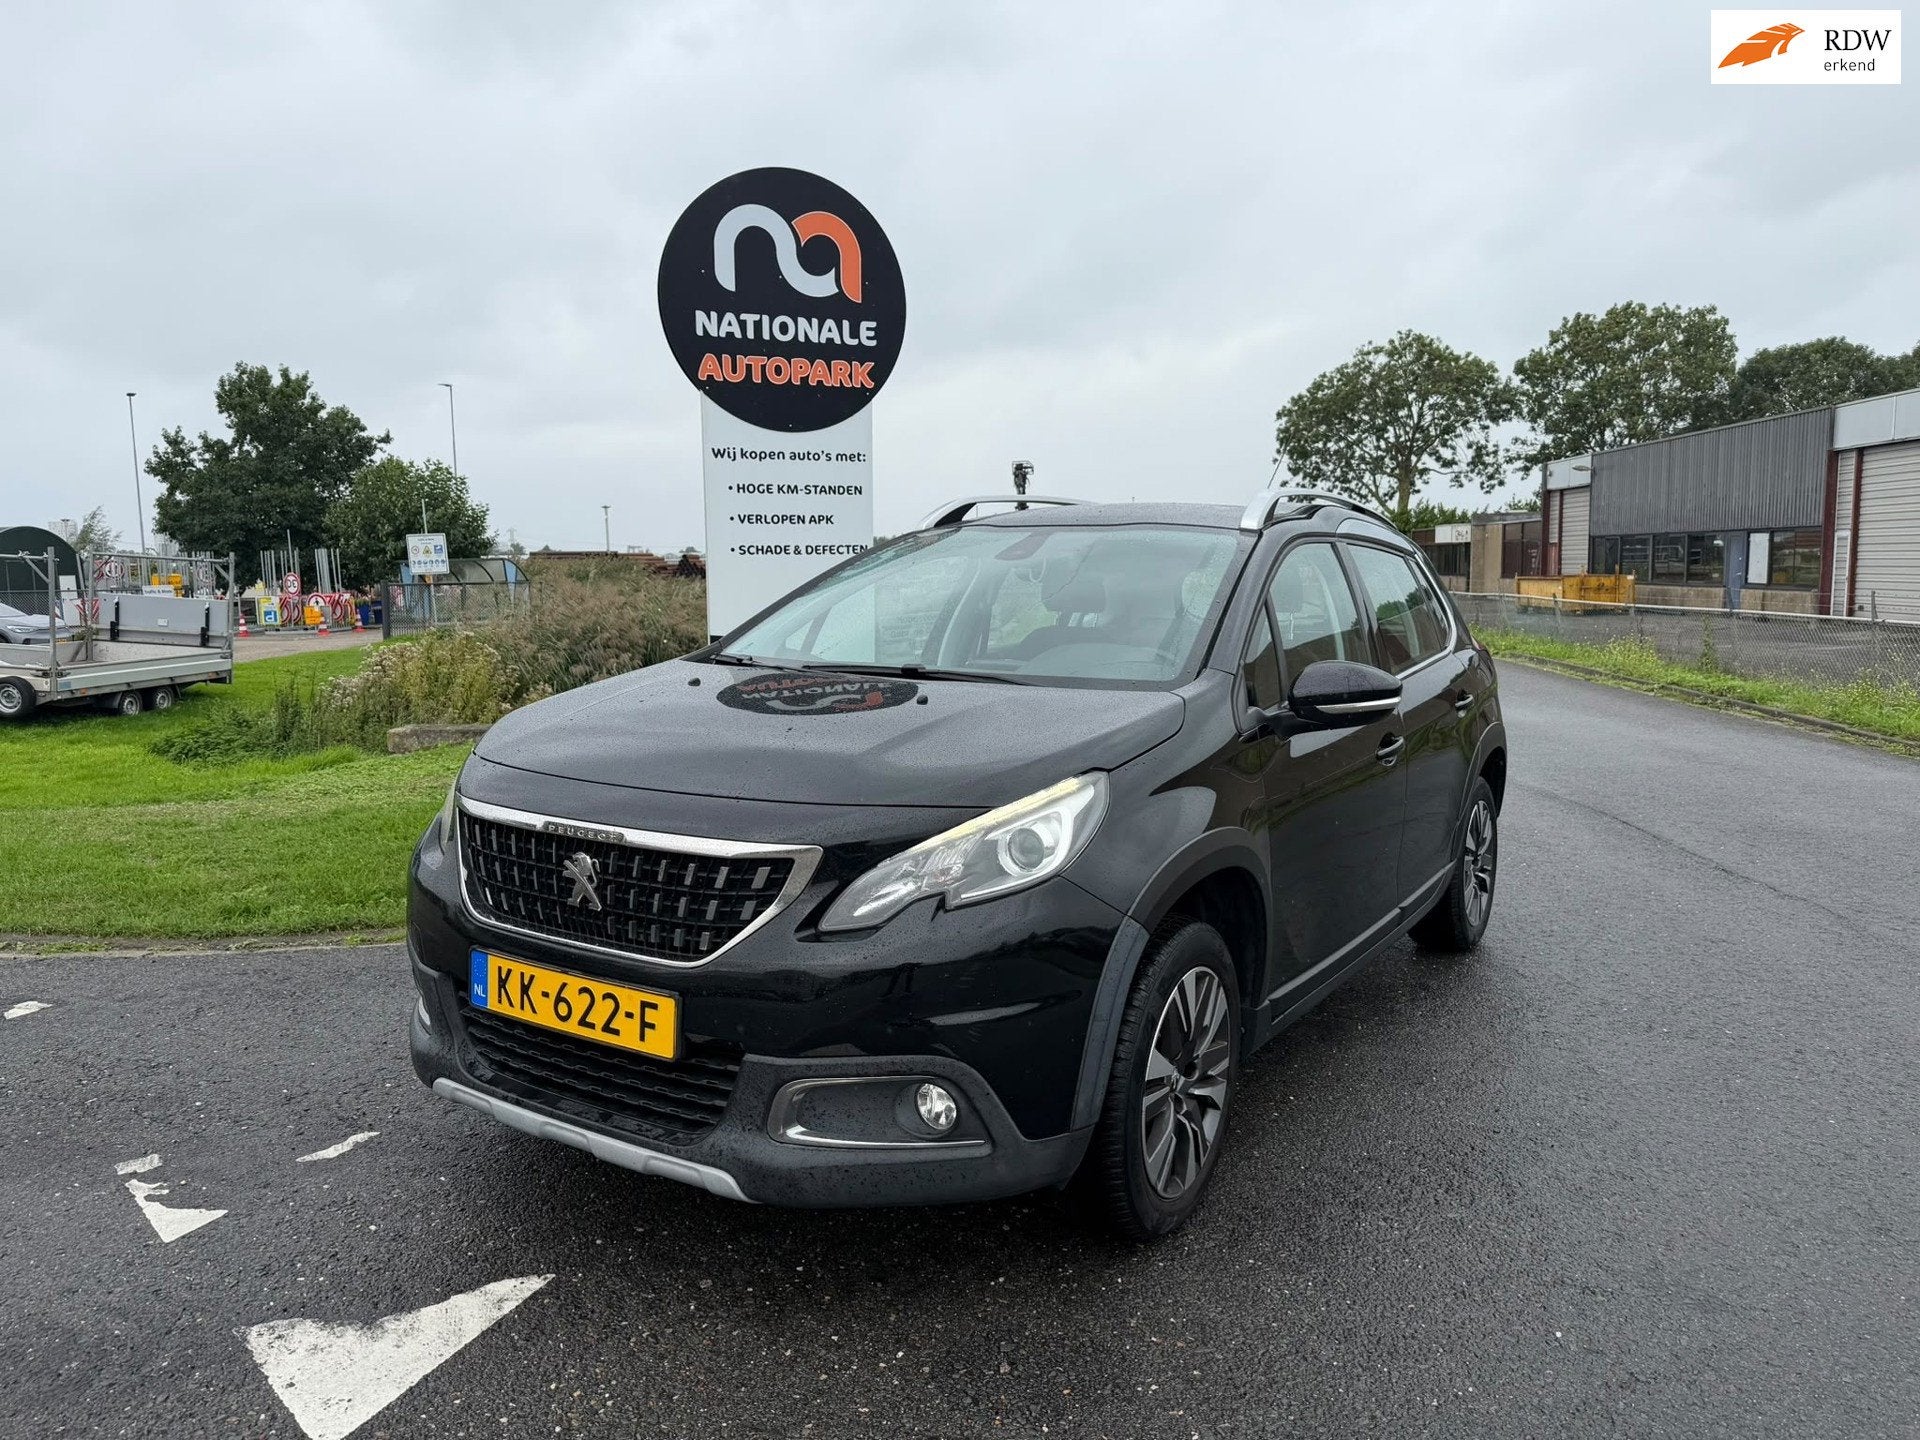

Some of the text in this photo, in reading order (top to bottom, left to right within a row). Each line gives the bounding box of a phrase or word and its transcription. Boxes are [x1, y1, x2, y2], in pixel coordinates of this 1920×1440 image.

[695, 310, 878, 347] NATIONALE
[698, 353, 876, 389] AUTOPARK
[711, 447, 867, 463] Wij kopen auto's met:
[736, 483, 863, 496] HOGE KM-STANDEN
[738, 514, 834, 525] VERLOPEN APK
[738, 544, 869, 556] SCHADE & DEFECTEN
[473, 984, 486, 998] NL
[497, 965, 659, 1043] KK-622-F
